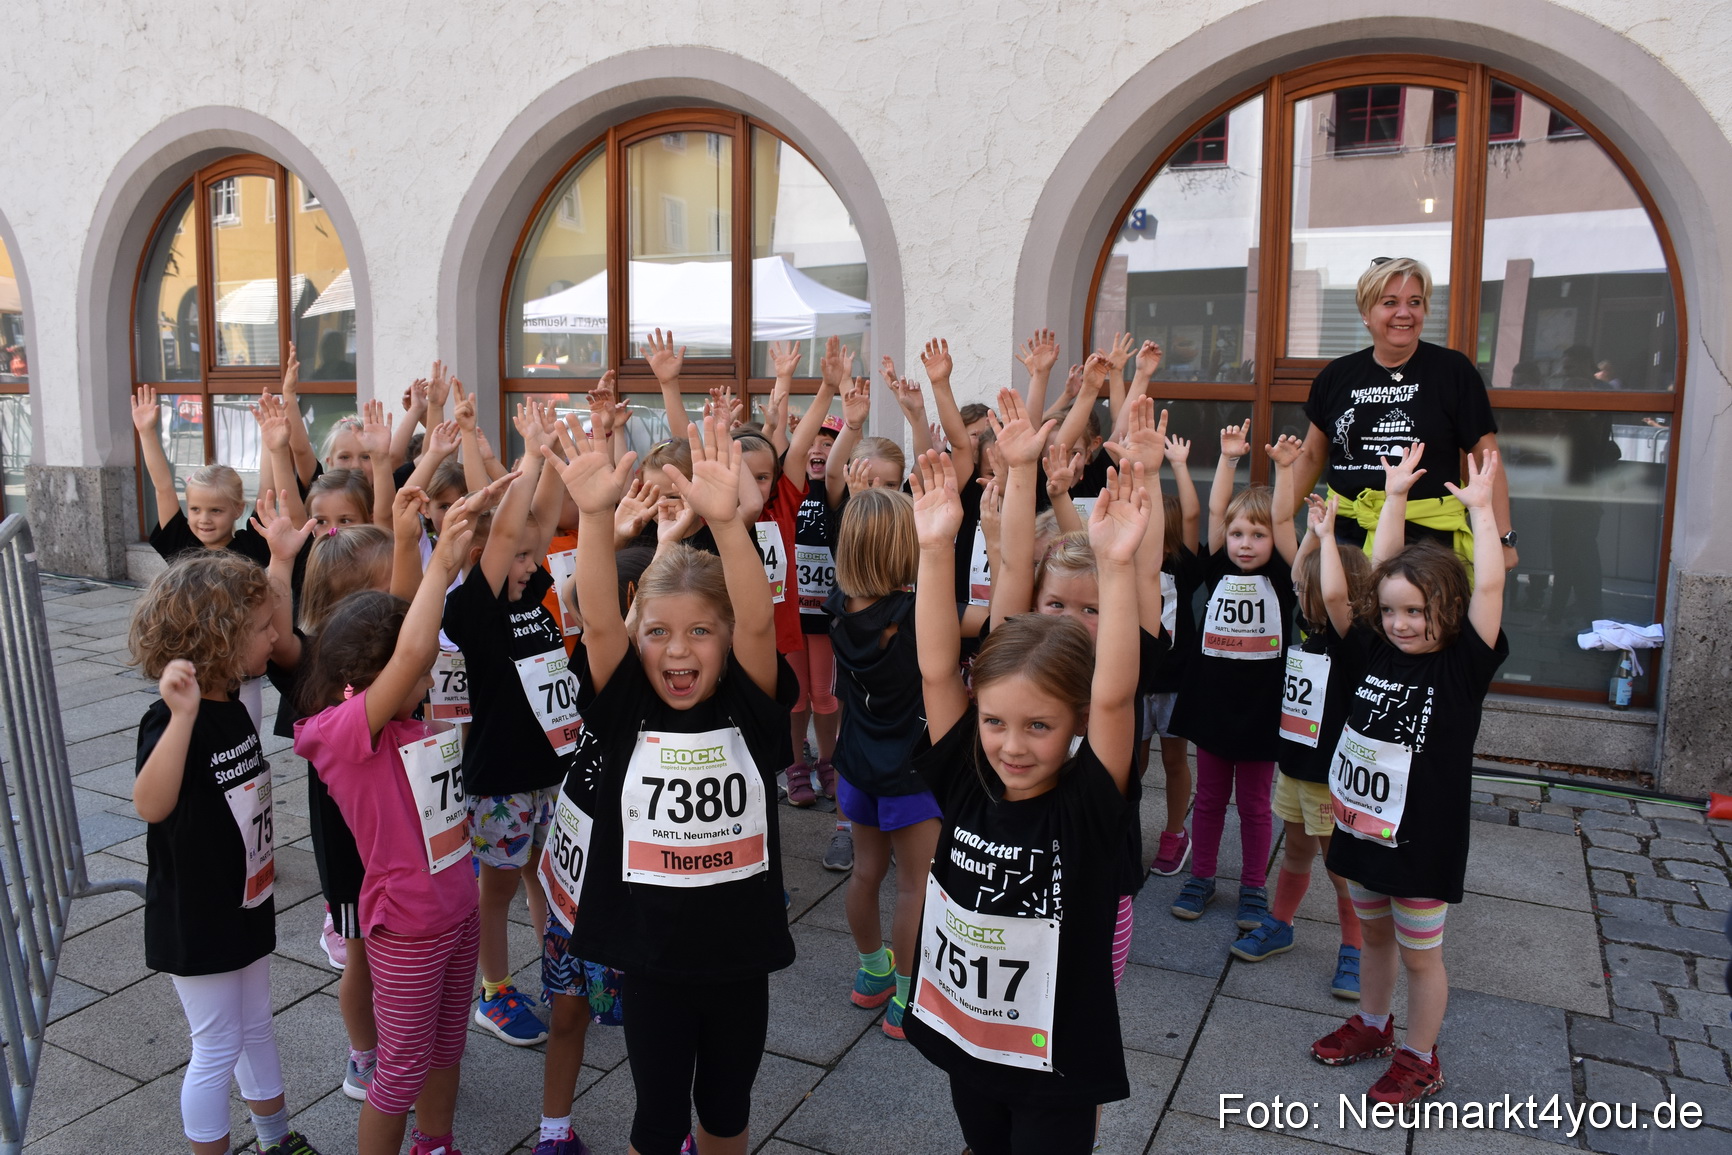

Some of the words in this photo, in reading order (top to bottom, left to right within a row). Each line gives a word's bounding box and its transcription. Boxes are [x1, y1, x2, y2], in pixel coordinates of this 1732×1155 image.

[1350, 383, 1420, 399] NEUMARKTER
[1353, 394, 1415, 405] STADTLAUF
[797, 551, 829, 560] BOCK
[796, 565, 836, 587] 349
[1214, 597, 1265, 624] 7501
[552, 713, 568, 724] PARTL
[1415, 687, 1434, 753] BAMBINI
[660, 745, 727, 765] BOCK
[1337, 751, 1390, 803] 7000
[431, 764, 465, 811] 75
[642, 772, 747, 824] 7380
[1345, 796, 1373, 811] Neumarkt
[425, 808, 432, 818] B1
[446, 810, 463, 823] PARTL
[629, 809, 639, 817] B5
[1343, 809, 1358, 826] Lif
[652, 829, 681, 840] PARTL
[684, 828, 730, 840] Neumarkt
[660, 850, 734, 870] Theresa
[946, 909, 1006, 945] BOCK
[964, 938, 979, 948] smart
[935, 925, 1030, 1003] 7517
[938, 978, 959, 1002] PARTL
[959, 998, 1003, 1018] Neumarkt
